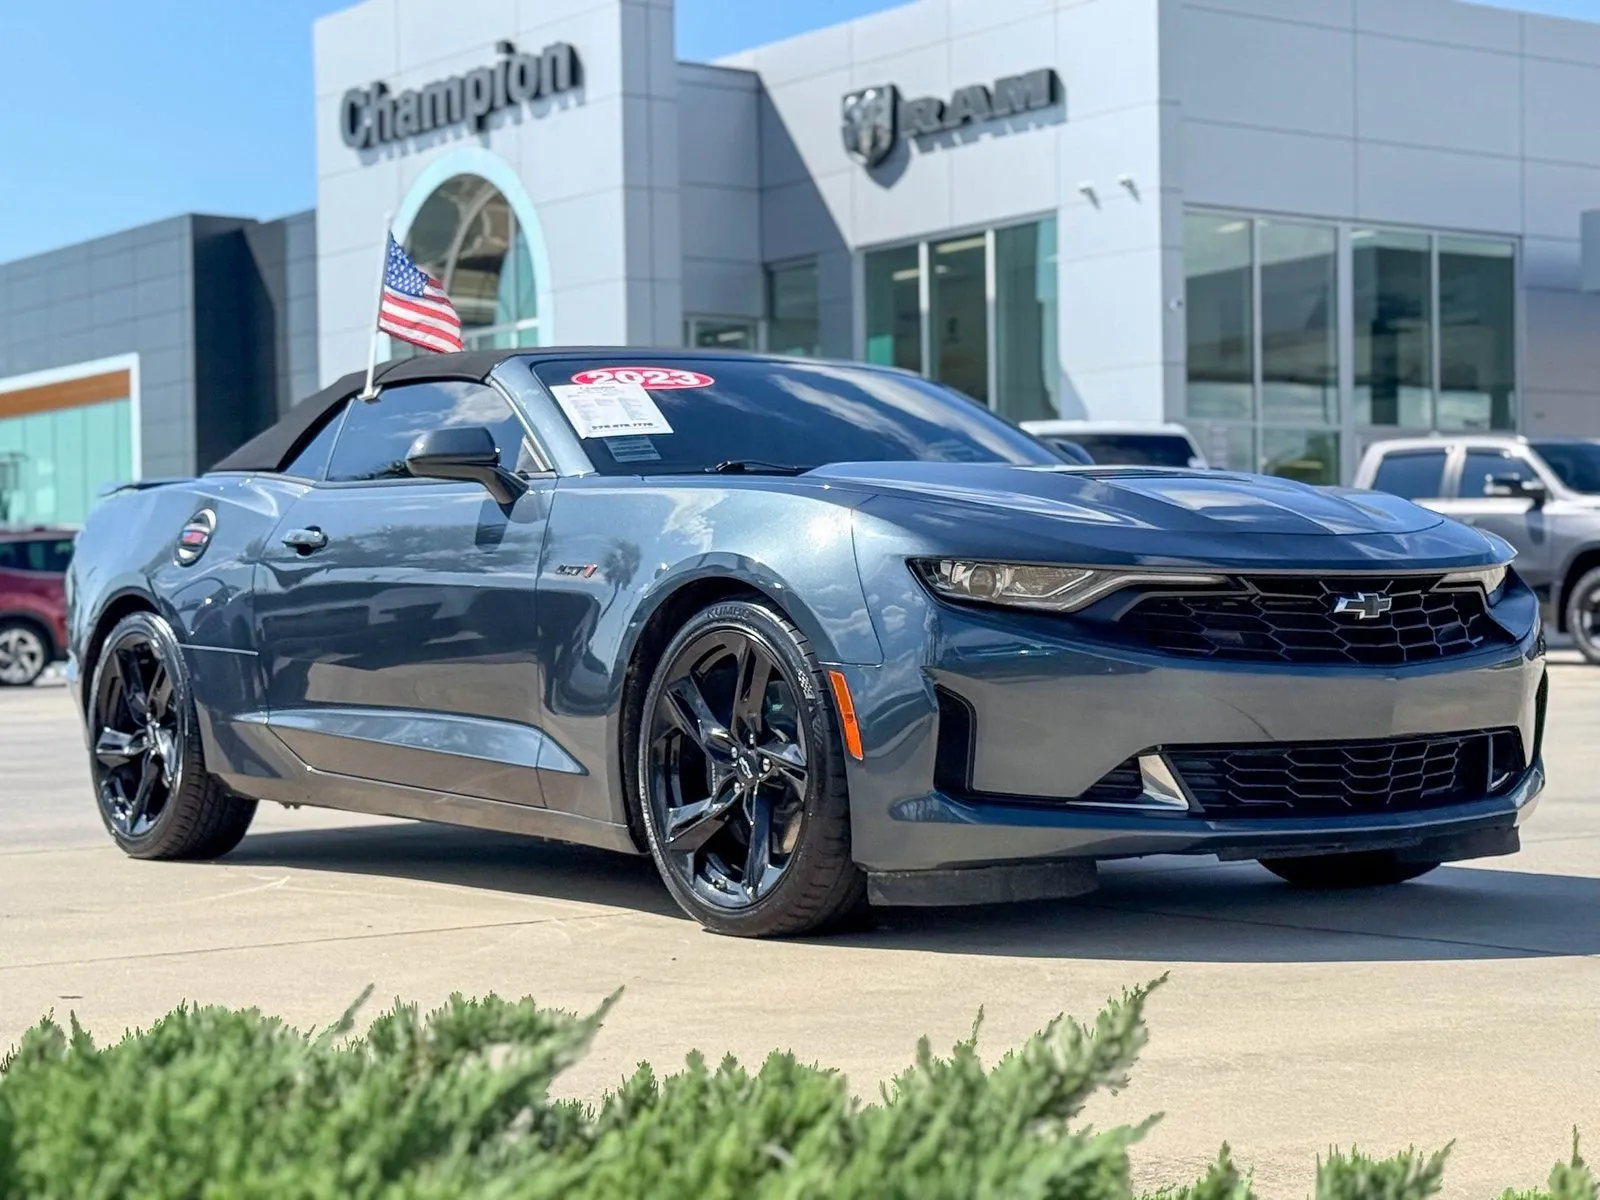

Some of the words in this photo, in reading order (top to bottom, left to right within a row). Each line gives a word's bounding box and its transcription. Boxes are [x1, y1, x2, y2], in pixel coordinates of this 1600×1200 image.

[340, 40, 580, 149] Champion
[900, 67, 1057, 138] RAM
[586, 370, 701, 386] 2023
